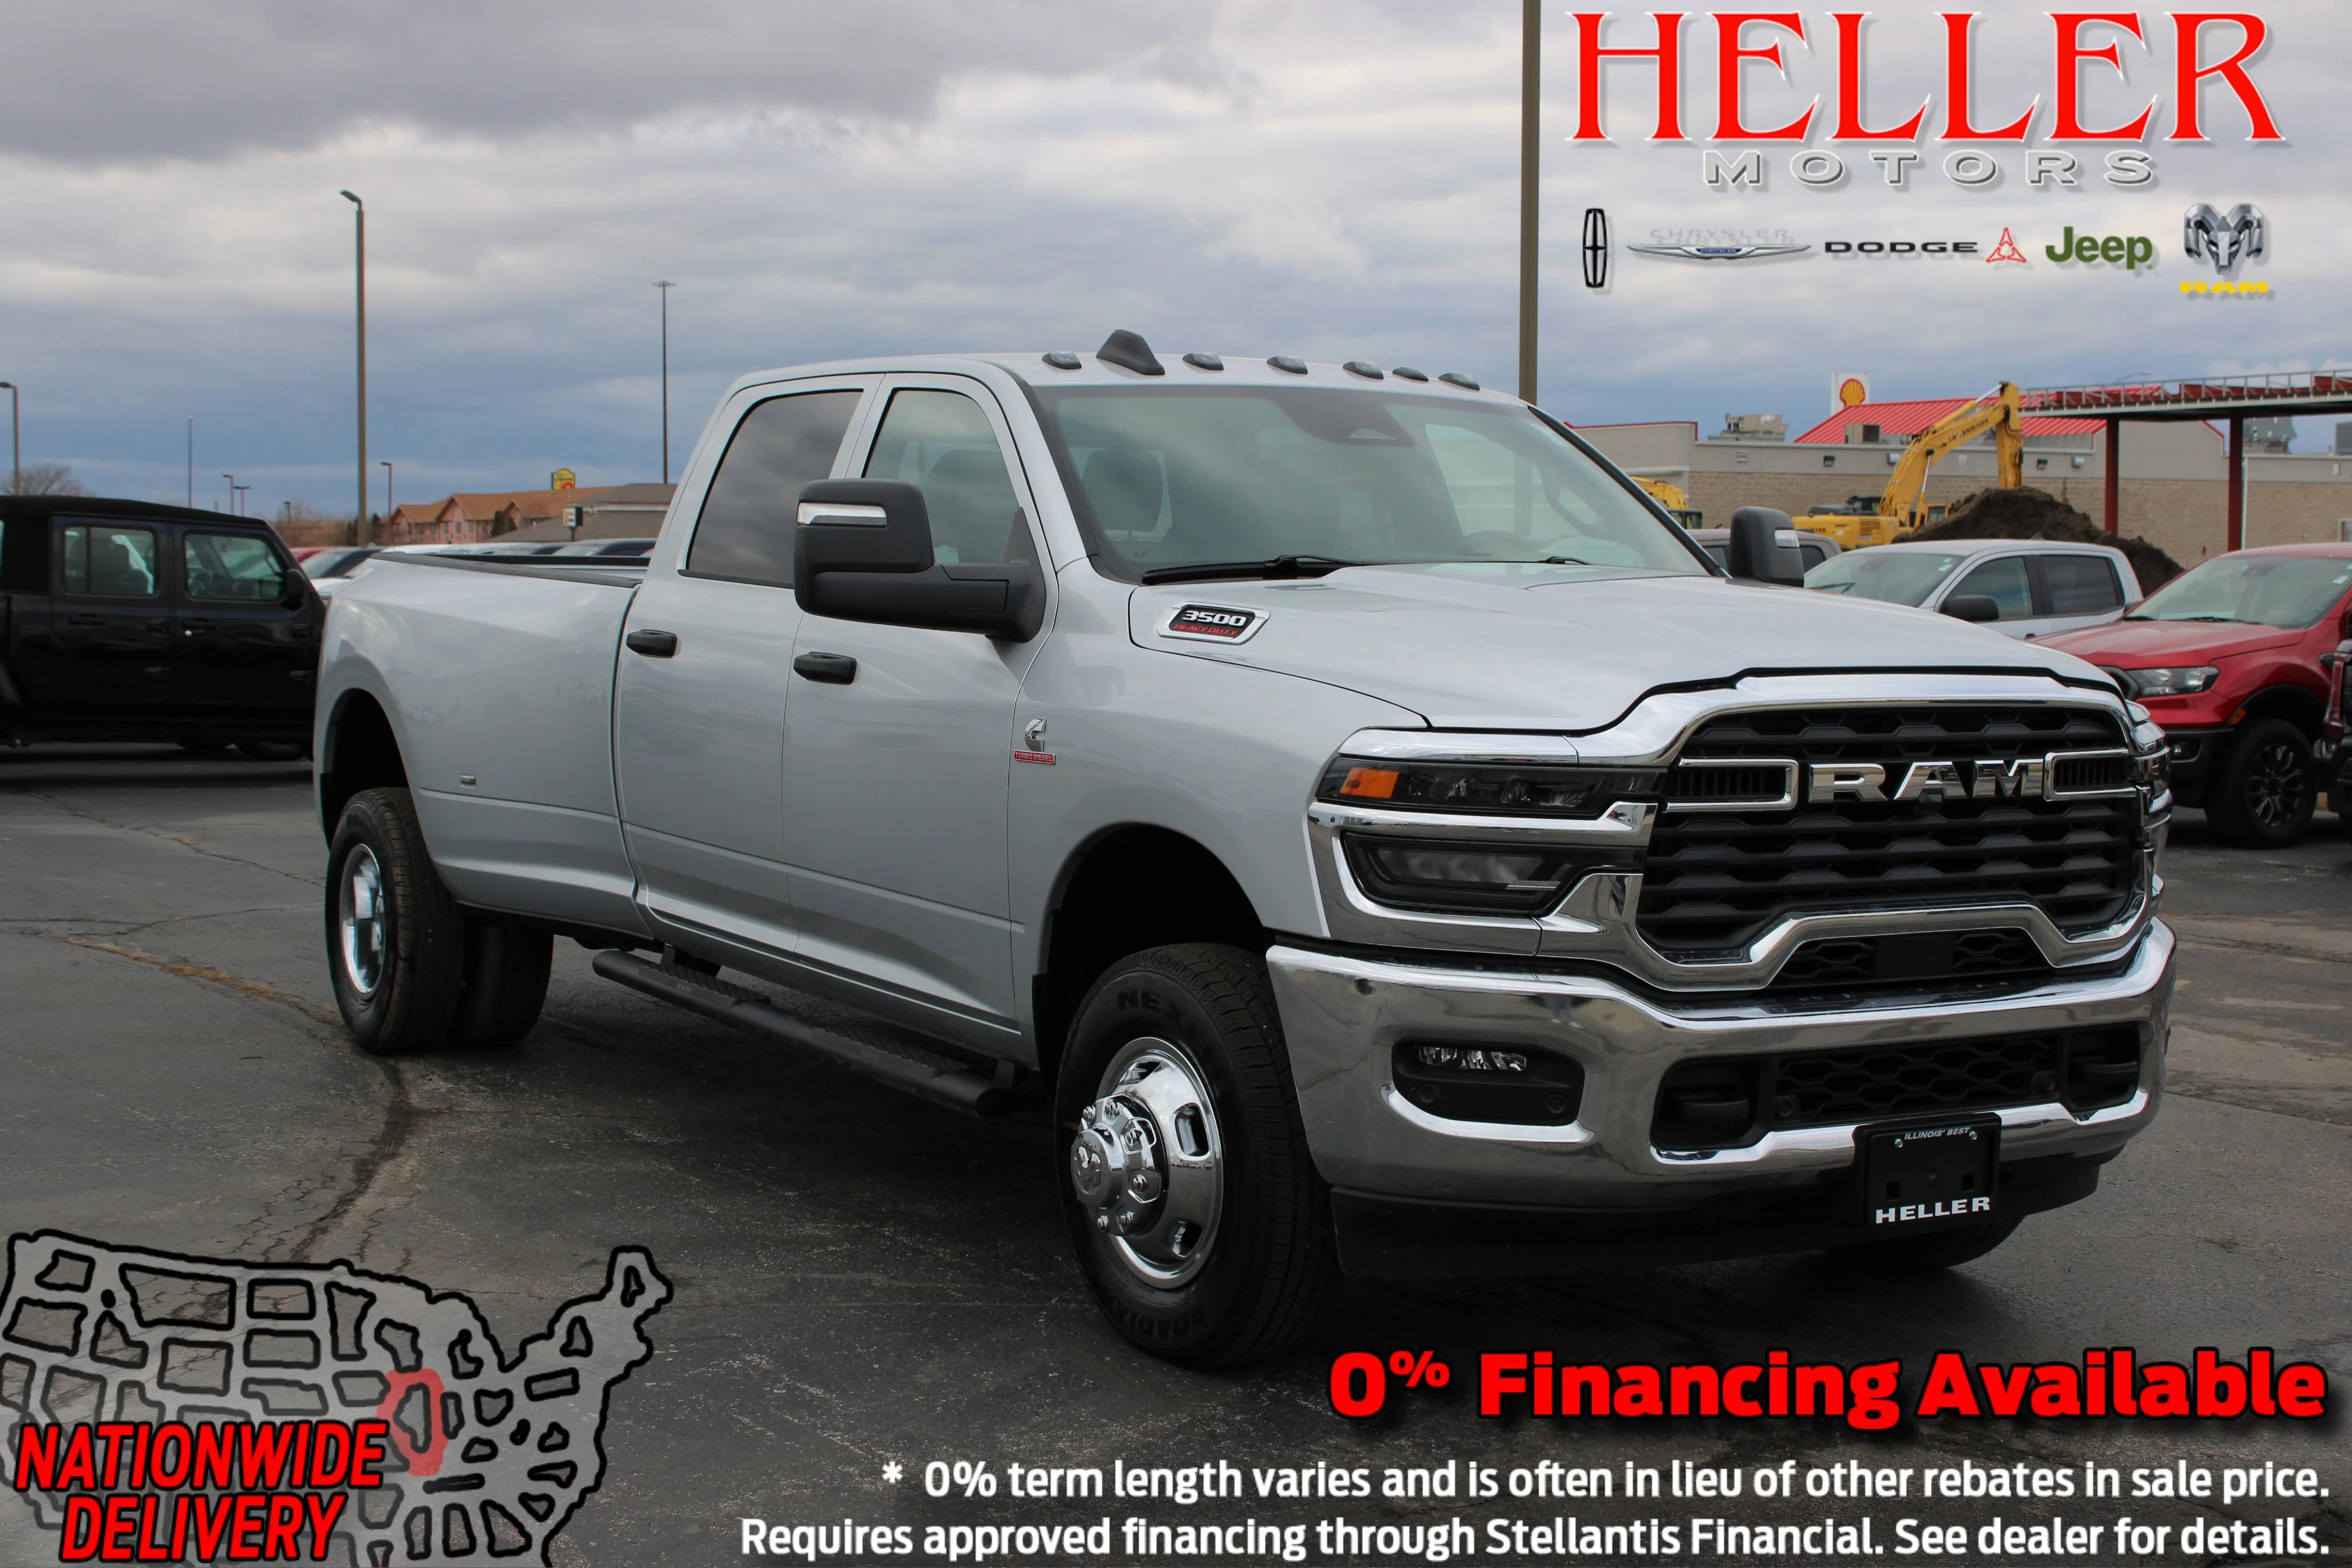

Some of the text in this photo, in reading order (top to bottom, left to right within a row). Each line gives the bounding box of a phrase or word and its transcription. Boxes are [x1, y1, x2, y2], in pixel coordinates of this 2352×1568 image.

[1182, 609, 1247, 627] 3500
[1174, 623, 1239, 636] HEAVY DUTY
[1024, 720, 1044, 737] Cummins
[1015, 752, 1053, 762] TURBO DIESEL
[1808, 758, 2044, 803] RAM
[1946, 1127, 1970, 1136] BEST
[1875, 1196, 1991, 1224] HELLER
